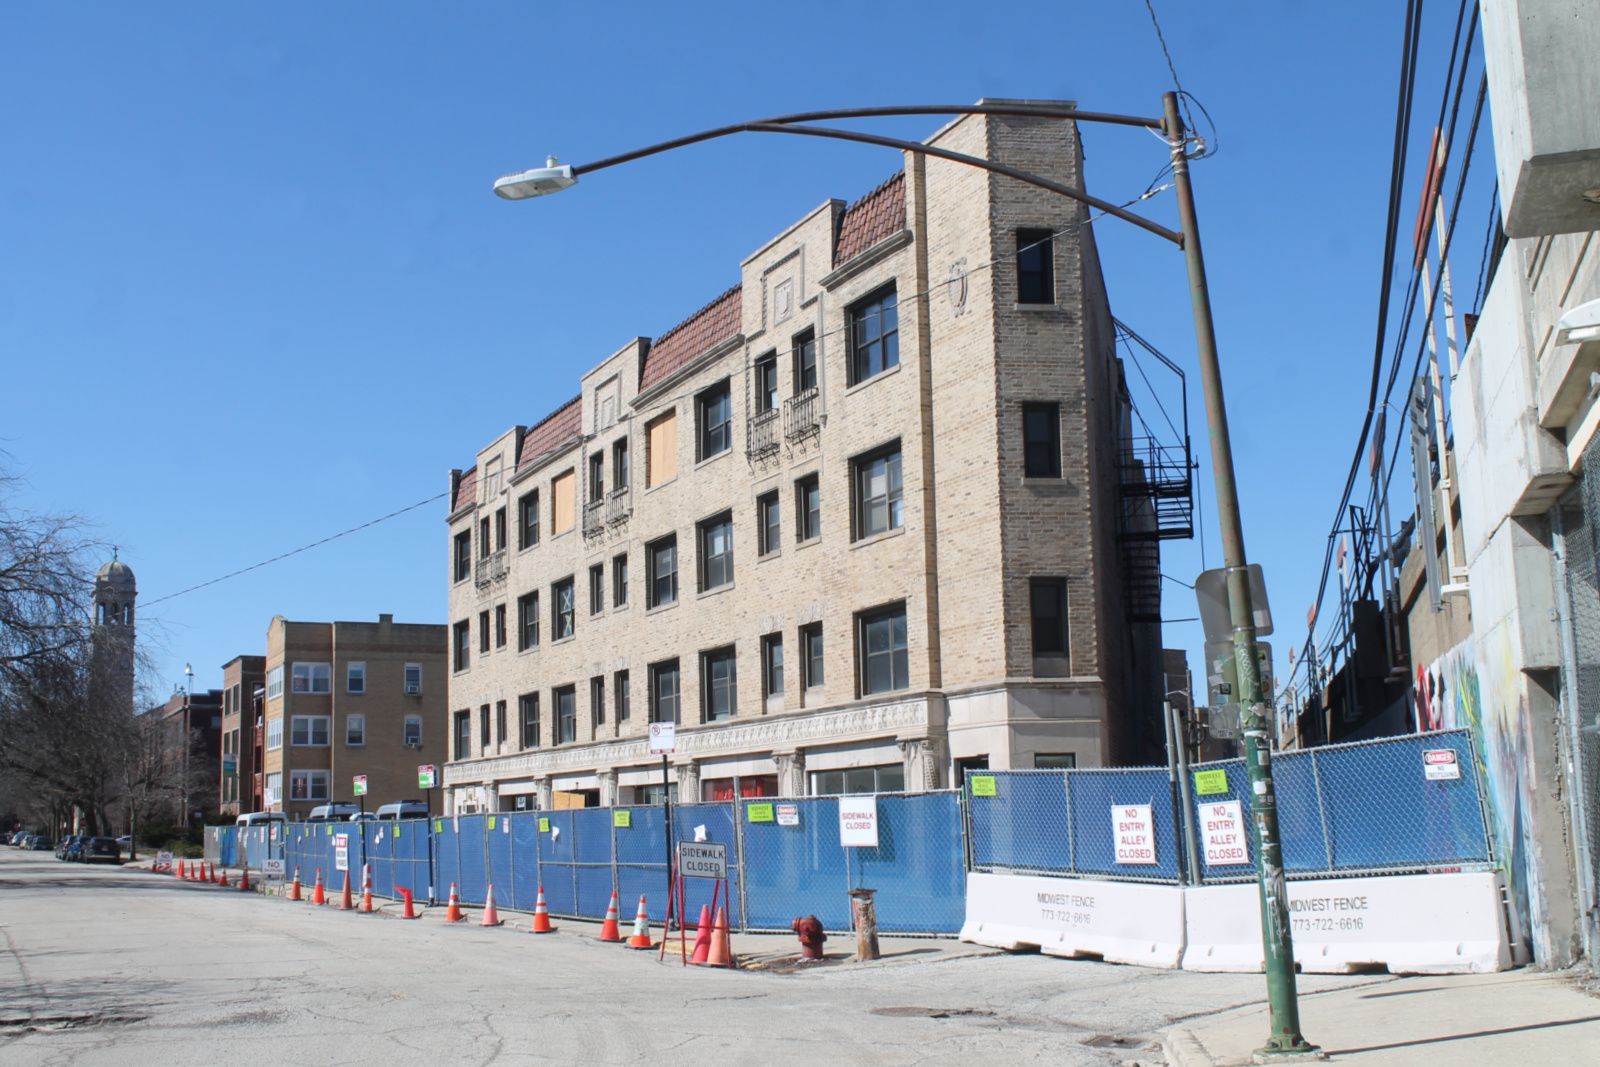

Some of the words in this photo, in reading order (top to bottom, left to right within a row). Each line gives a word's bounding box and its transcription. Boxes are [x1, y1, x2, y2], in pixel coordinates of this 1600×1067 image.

[842, 812, 873, 820] SIDEWALK
[1125, 809, 1137, 818] NO
[1213, 806, 1226, 816] NO
[1119, 822, 1145, 831] ENTRY
[1207, 820, 1235, 831] ENTRY
[1121, 835, 1146, 845] ALLEY
[1210, 834, 1237, 845] ALLEY
[682, 847, 724, 859] SIDEWALK
[1118, 849, 1151, 858] CLOSED
[1208, 848, 1243, 859] CLOSED
[687, 861, 720, 872] CLOSED
[1037, 892, 1069, 905] MIDWEST
[1071, 895, 1095, 907] FENCE
[1288, 898, 1330, 912] MIDWEST
[1334, 896, 1368, 910] FENCE
[1293, 917, 1363, 931] 773-722-6616
